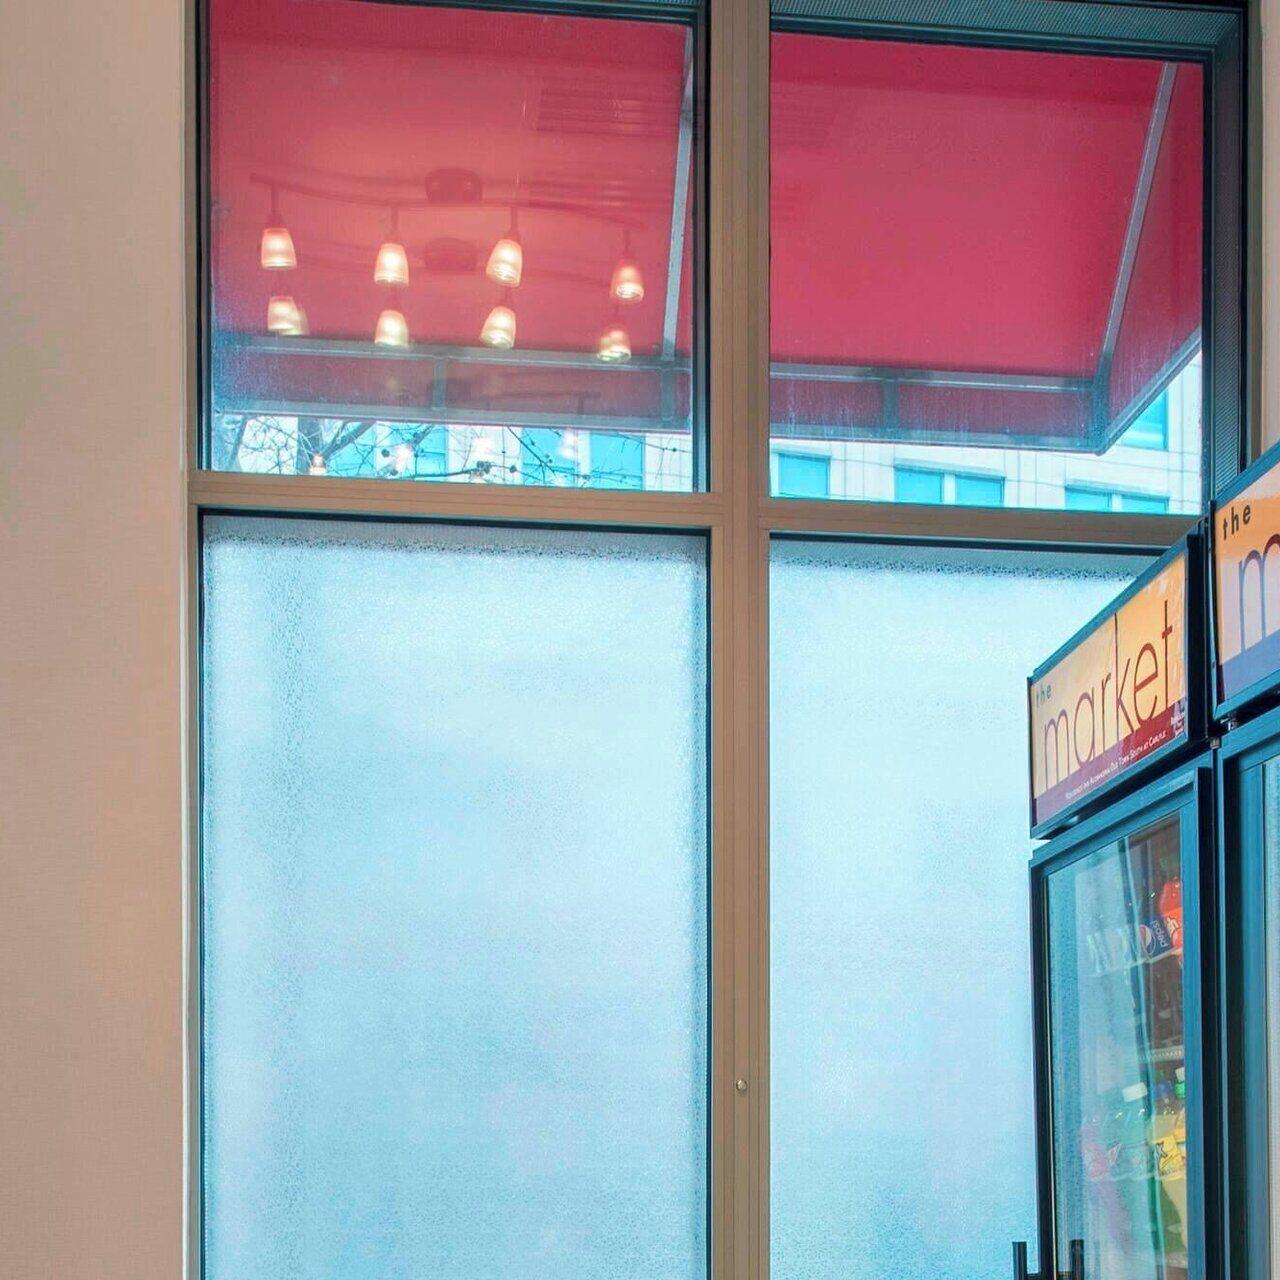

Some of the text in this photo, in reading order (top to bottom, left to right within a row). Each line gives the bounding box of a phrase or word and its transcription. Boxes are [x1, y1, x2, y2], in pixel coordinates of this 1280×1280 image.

[1223, 504, 1252, 541] the
[1036, 683, 1052, 708] the
[1044, 600, 1173, 793] market
